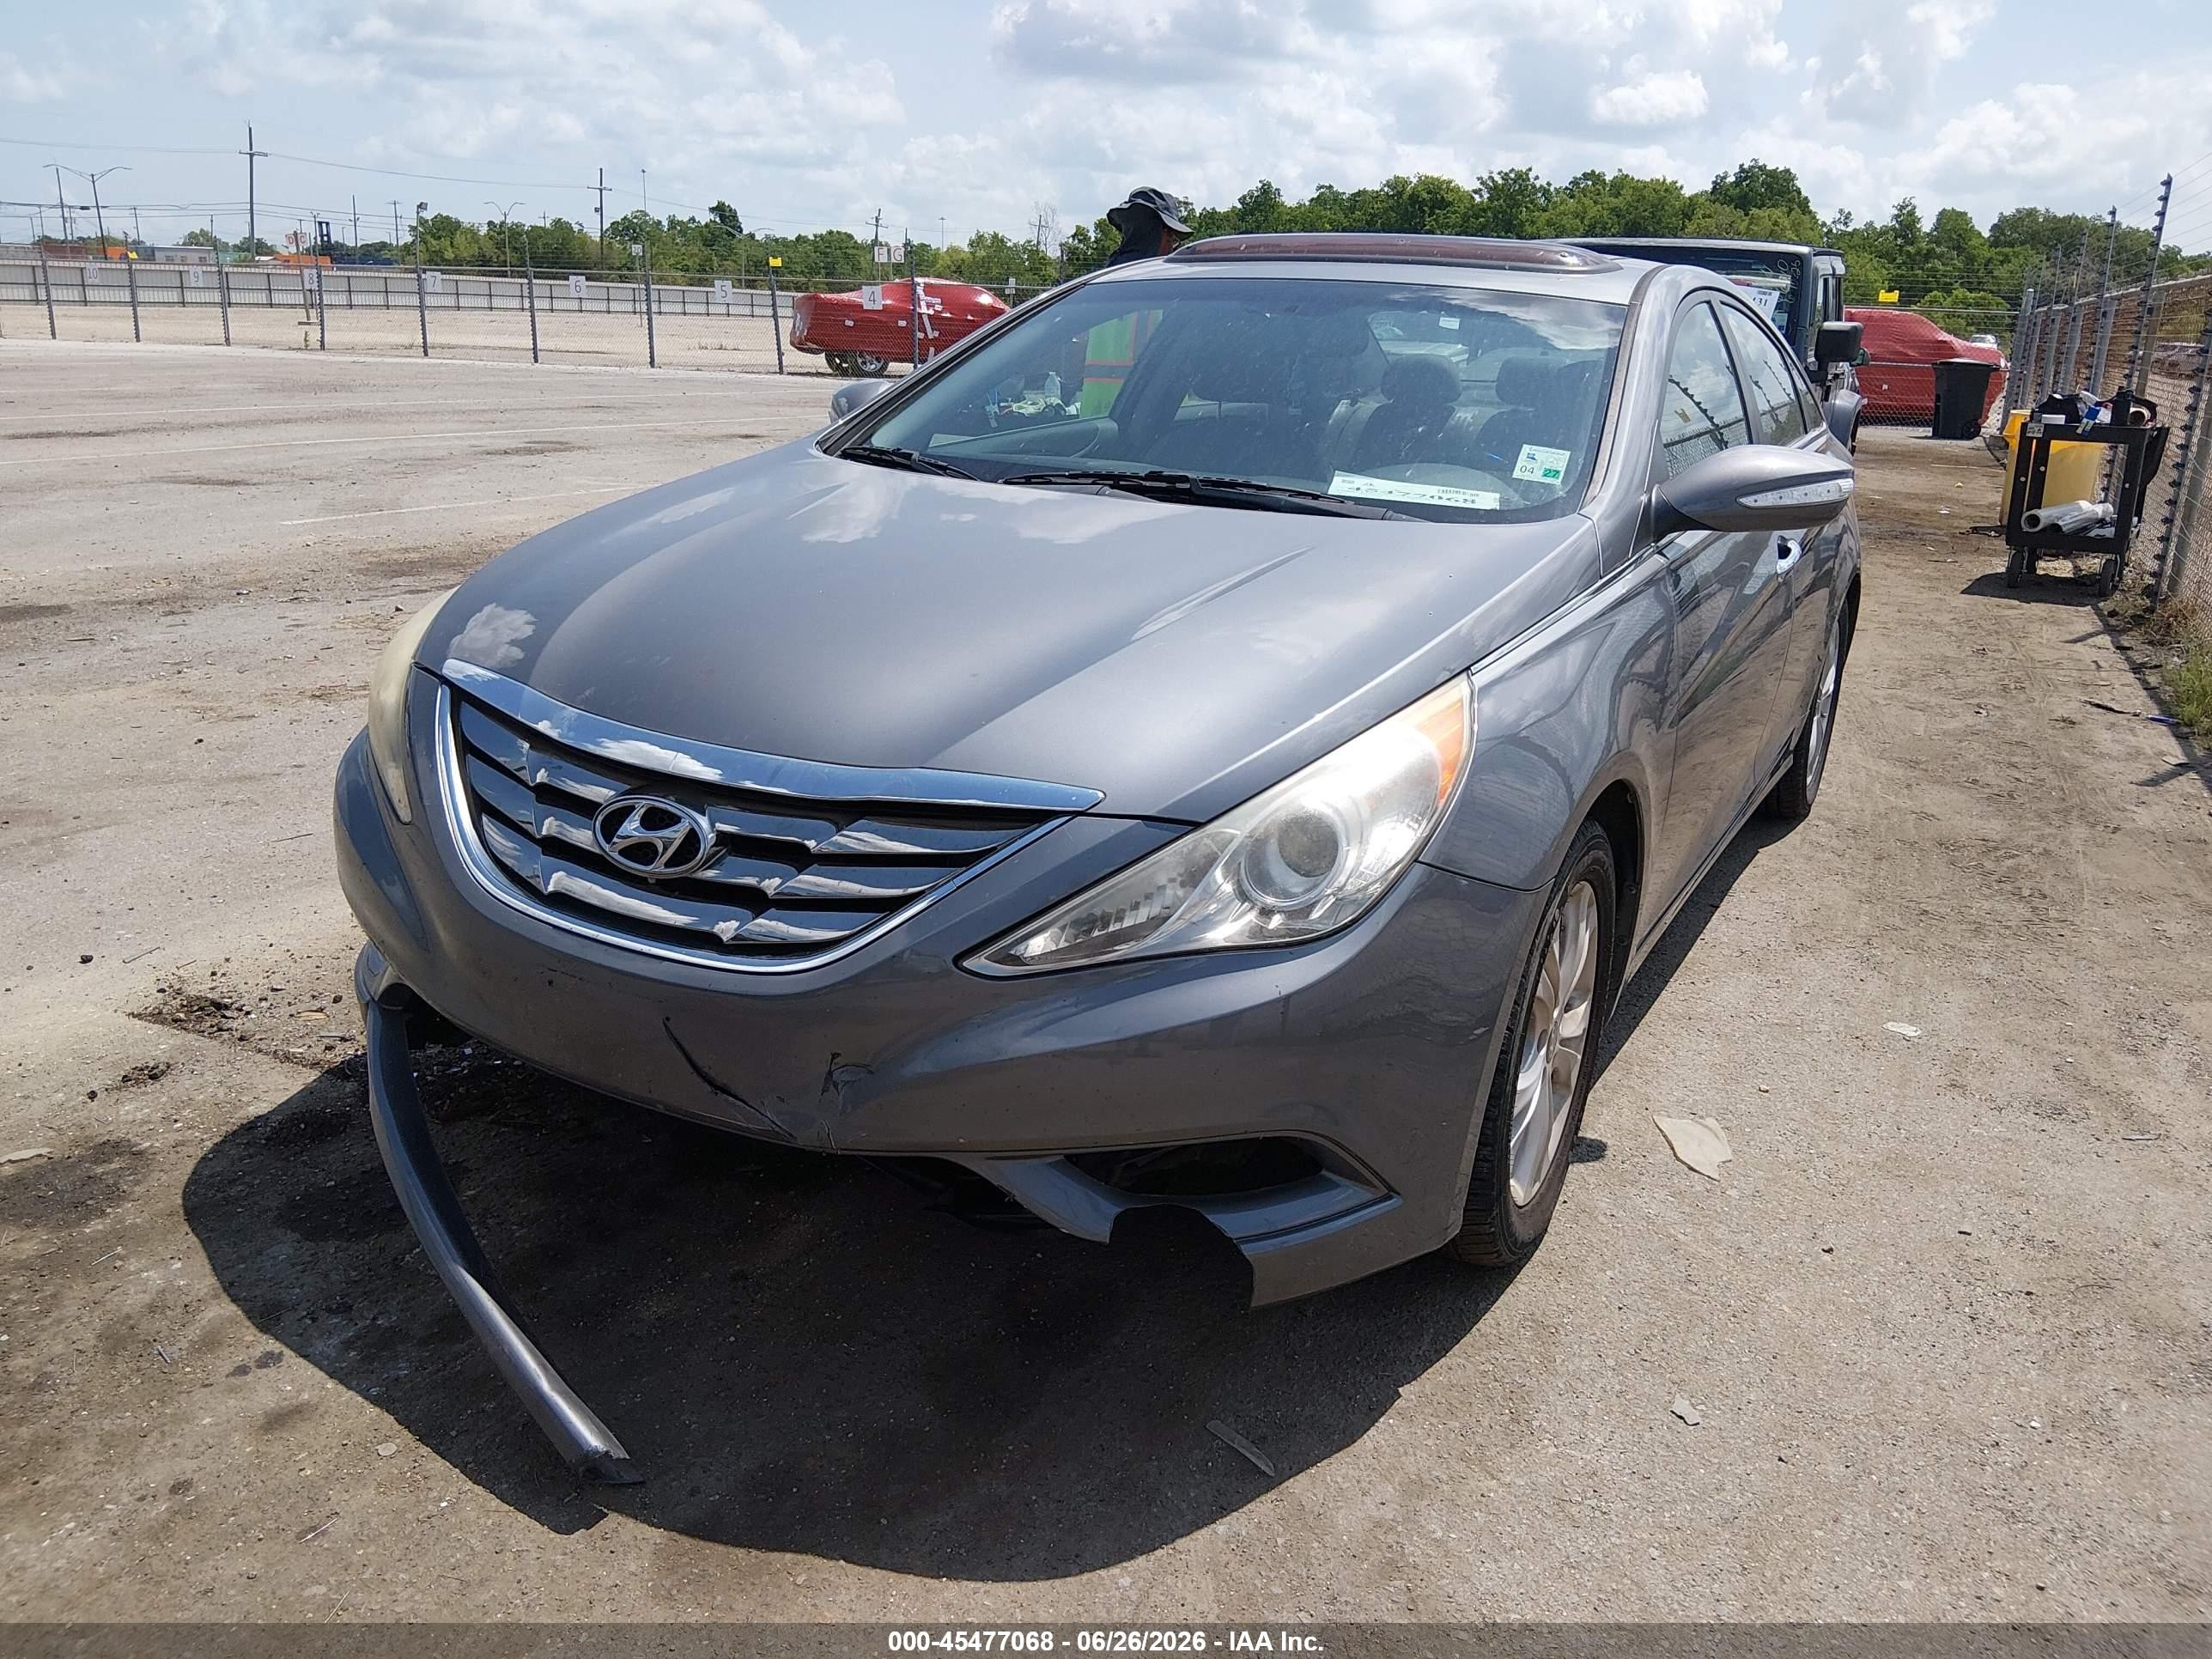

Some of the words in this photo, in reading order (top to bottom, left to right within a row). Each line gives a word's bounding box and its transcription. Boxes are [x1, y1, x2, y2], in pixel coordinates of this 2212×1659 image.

[288, 235, 295, 245] D
[300, 235, 306, 244] C
[878, 247, 886, 262] F
[893, 247, 902, 262] G
[88, 268, 98, 279] 10
[193, 271, 199, 283] 9
[308, 273, 314, 285] 8
[430, 275, 437, 289] 7
[574, 280, 582, 294] 6
[720, 284, 728, 299] 5
[868, 290, 877, 306] 4
[1520, 465, 1534, 475] 04
[1544, 468, 1559, 478] 27
